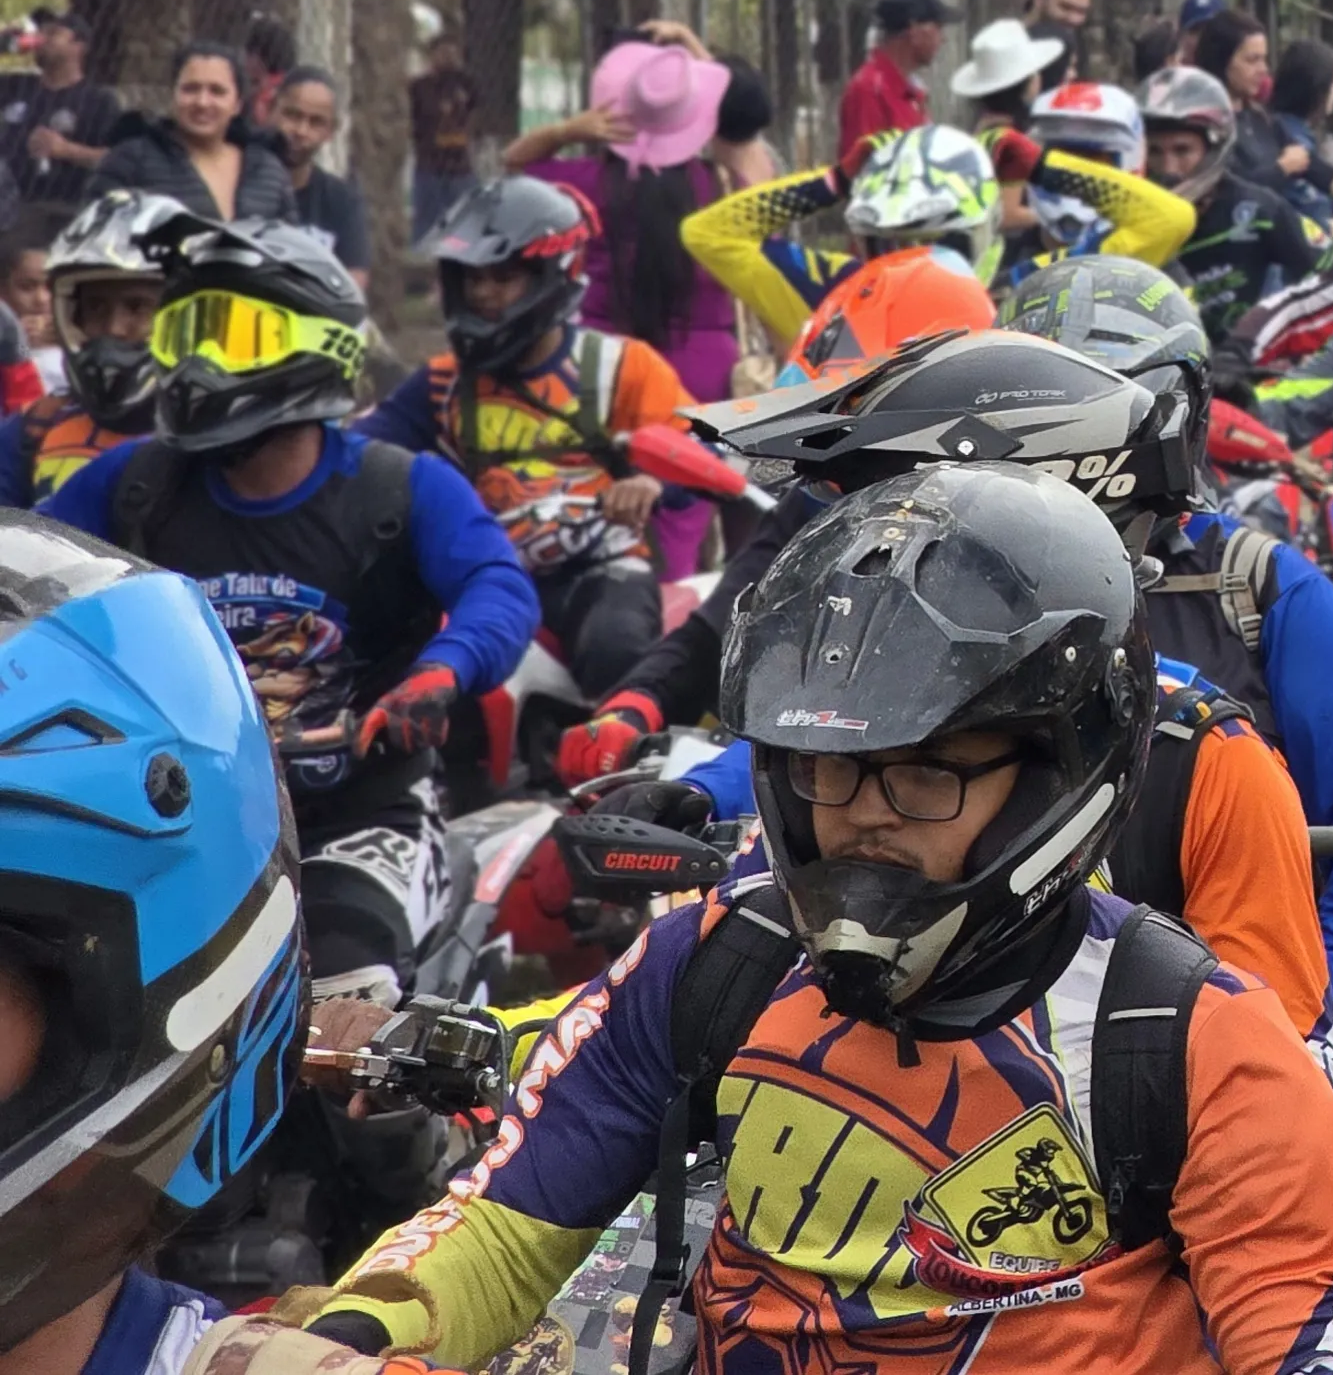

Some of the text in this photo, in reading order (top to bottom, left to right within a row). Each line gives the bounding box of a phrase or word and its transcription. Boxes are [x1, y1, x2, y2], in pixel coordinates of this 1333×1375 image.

[271, 574, 297, 597] de
[605, 852, 682, 873] CIRCUIT
[949, 1290, 1044, 1312] ALBERTINA
[1055, 1284, 1082, 1298] MG
